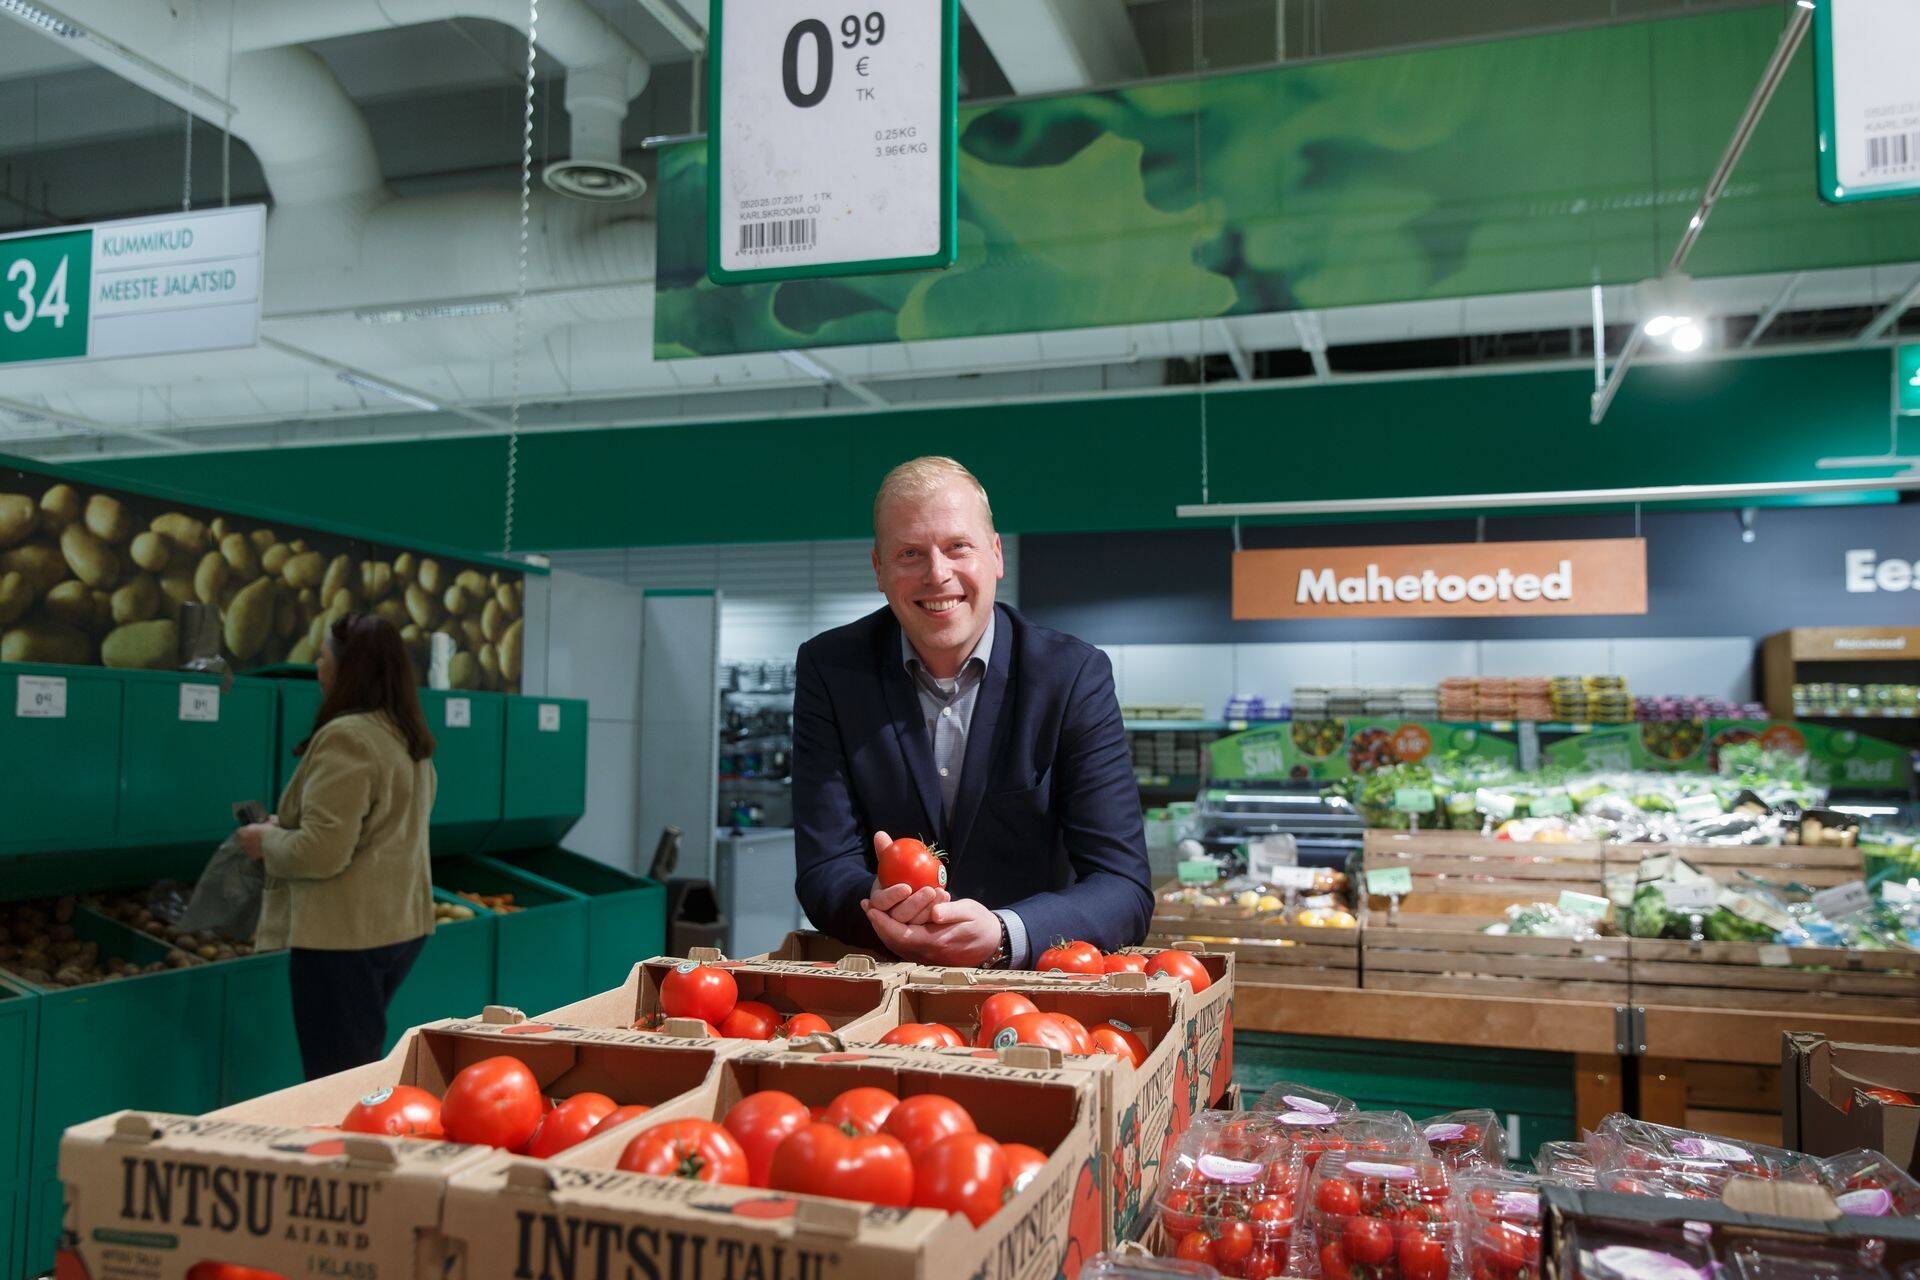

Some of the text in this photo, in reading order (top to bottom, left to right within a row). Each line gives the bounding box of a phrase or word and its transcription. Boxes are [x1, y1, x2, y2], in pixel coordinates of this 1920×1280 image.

[782, 11, 885, 108] 0 99
[856, 56, 870, 77] €
[856, 88, 875, 101] TK
[102, 228, 194, 257] KUMMIKUD
[4, 254, 71, 333] 34
[100, 269, 236, 303] MEESTE JALATSID
[1296, 558, 1573, 606] Mahetooted
[121, 1157, 370, 1236] INTSU TALU
[284, 1224, 371, 1250] AIAND
[513, 1210, 826, 1280] INTSU TALU
[318, 1255, 379, 1280] KLASS
